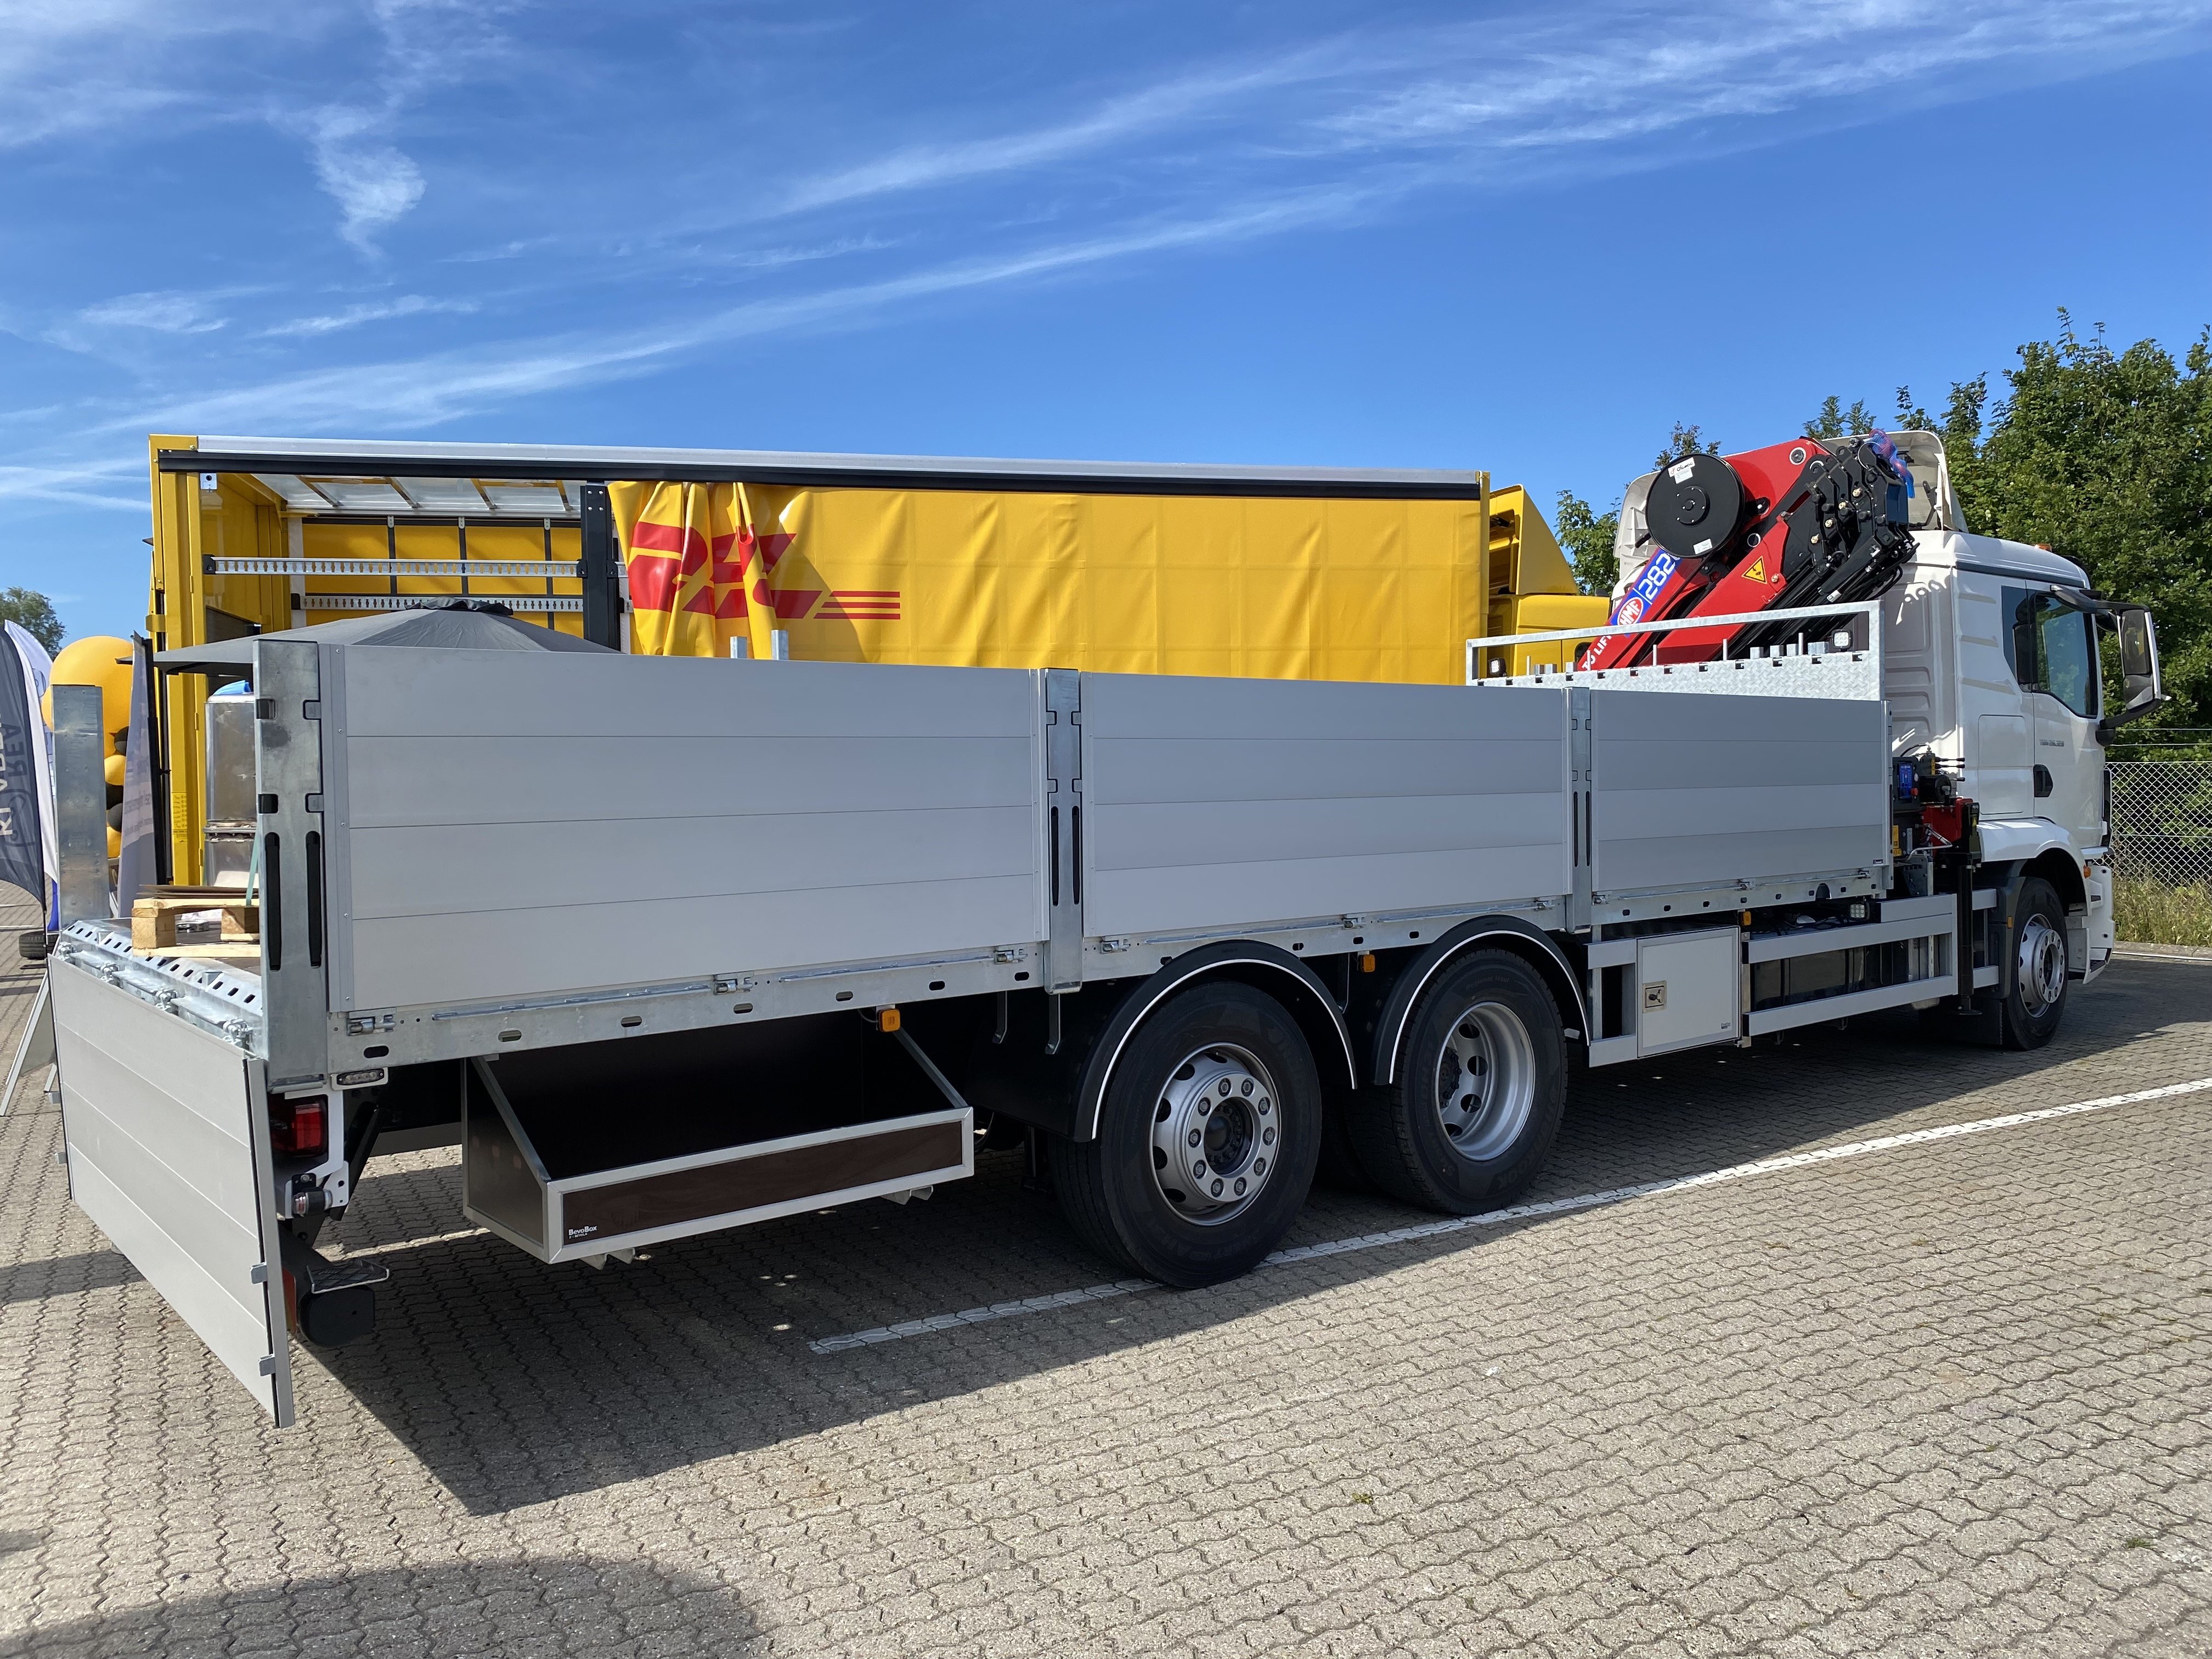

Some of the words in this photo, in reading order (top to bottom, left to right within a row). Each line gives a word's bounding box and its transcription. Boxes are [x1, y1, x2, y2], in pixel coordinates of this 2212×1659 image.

[1620, 600, 1641, 625] HMF
[1465, 976, 1493, 992] Regional
[1494, 974, 1509, 985] Haul
[568, 1226, 597, 1235] BevoBox
